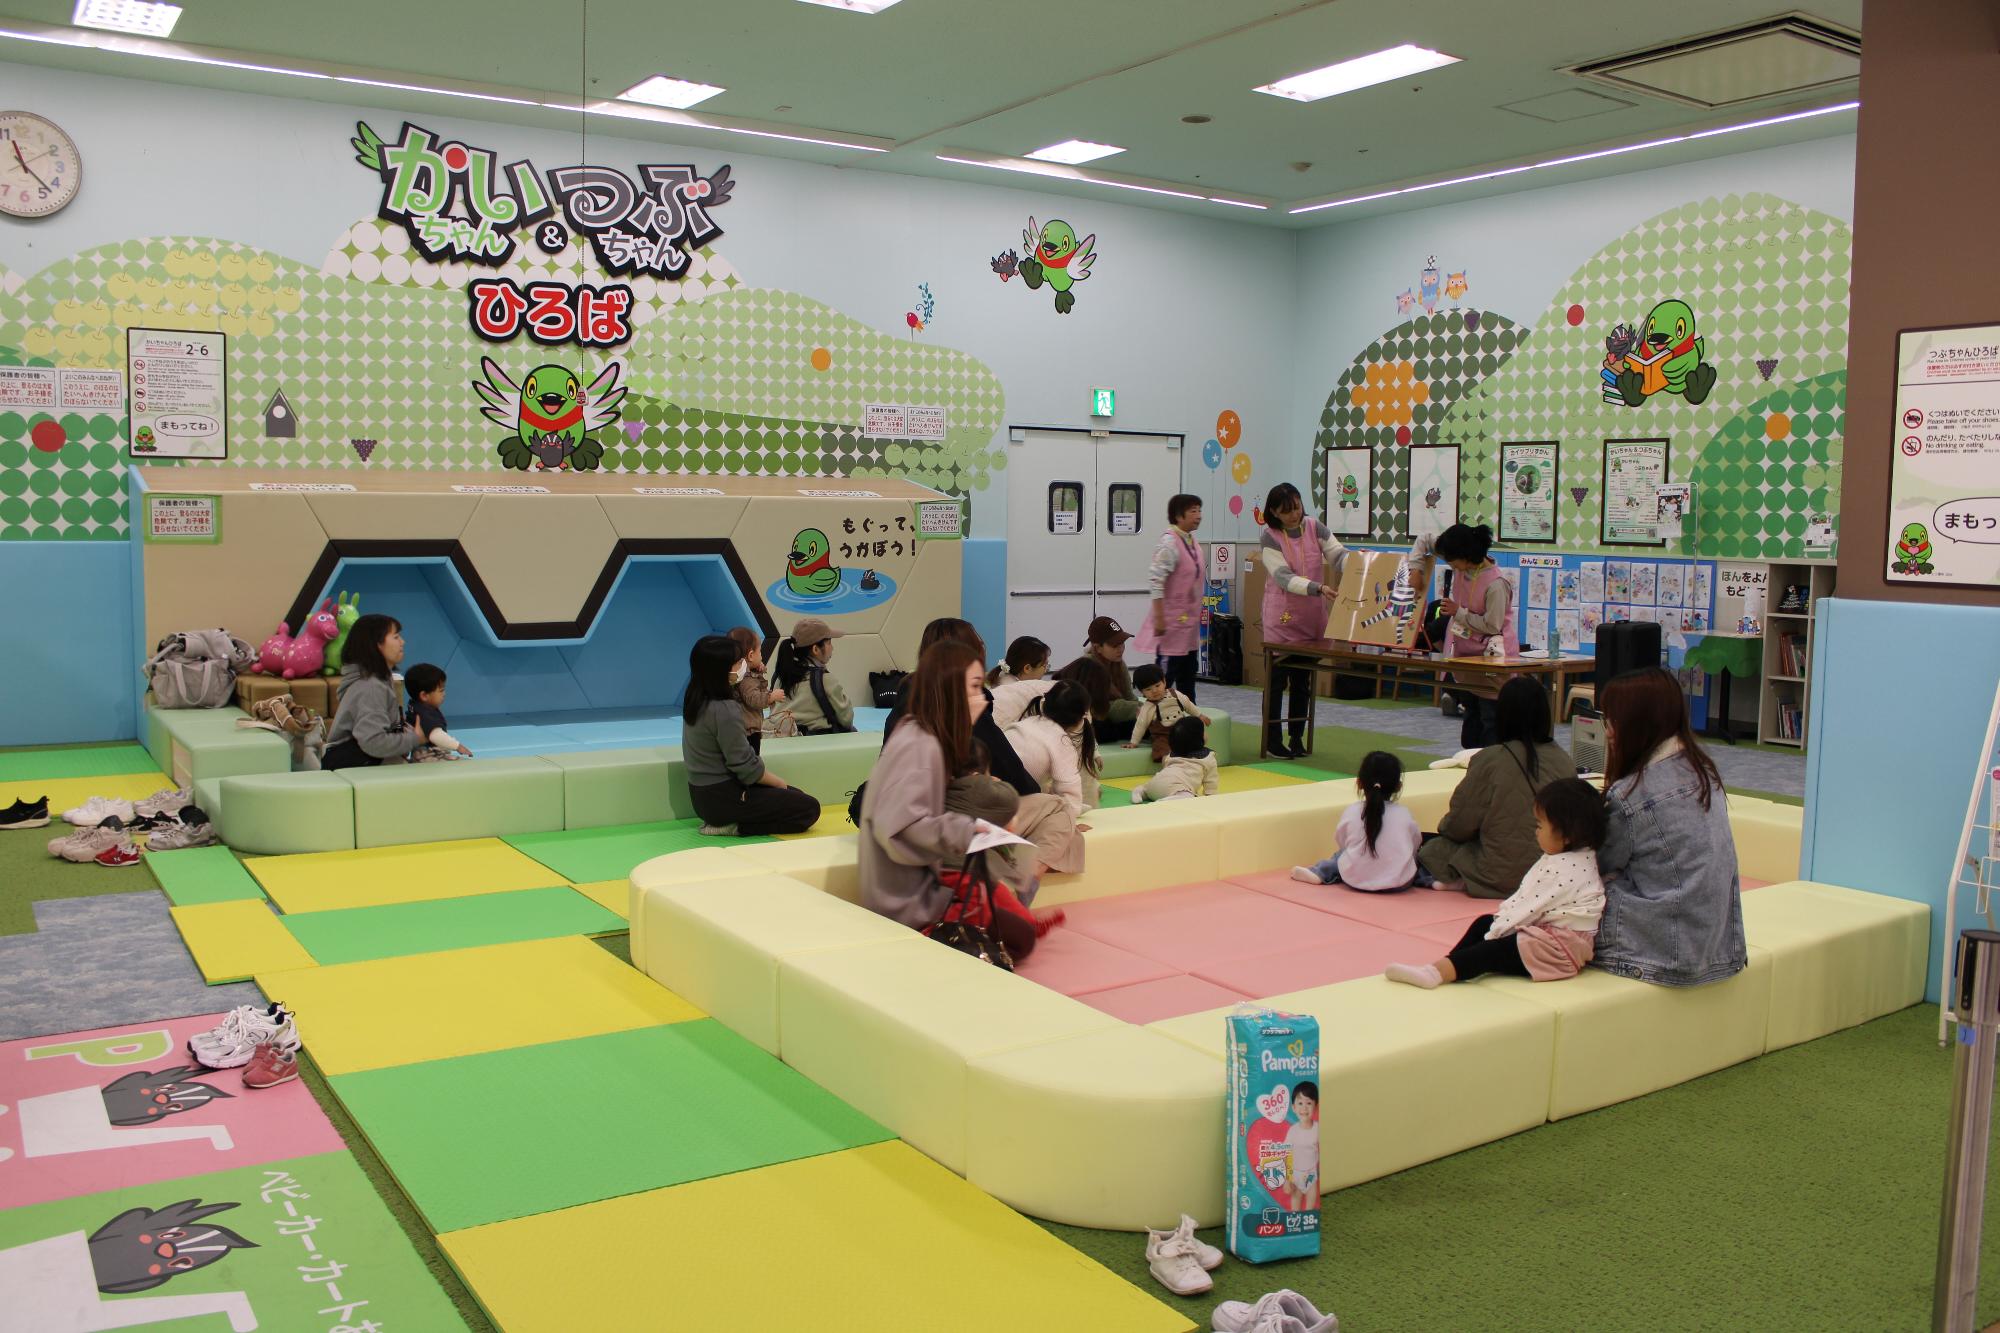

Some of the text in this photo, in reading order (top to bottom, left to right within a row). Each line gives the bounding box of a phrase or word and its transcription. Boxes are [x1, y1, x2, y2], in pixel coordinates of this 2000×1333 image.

[51, 177, 60, 188] 4
[383, 127, 548, 224] かい
[38, 187, 47, 199] 5
[555, 166, 714, 238] つぶ
[412, 213, 508, 256] ちゃん
[543, 225, 564, 248] &
[598, 228, 684, 270] ちゃん
[474, 284, 628, 341] ひろば
[186, 344, 209, 356] 2-6
[1930, 345, 1999, 358] つぶちゃんひろば
[161, 421, 214, 430] まもってね！
[840, 539, 915, 559] うかぼう！
[1262, 1050, 1318, 1073] Pampers
[1258, 1225, 1282, 1234] パンツ
